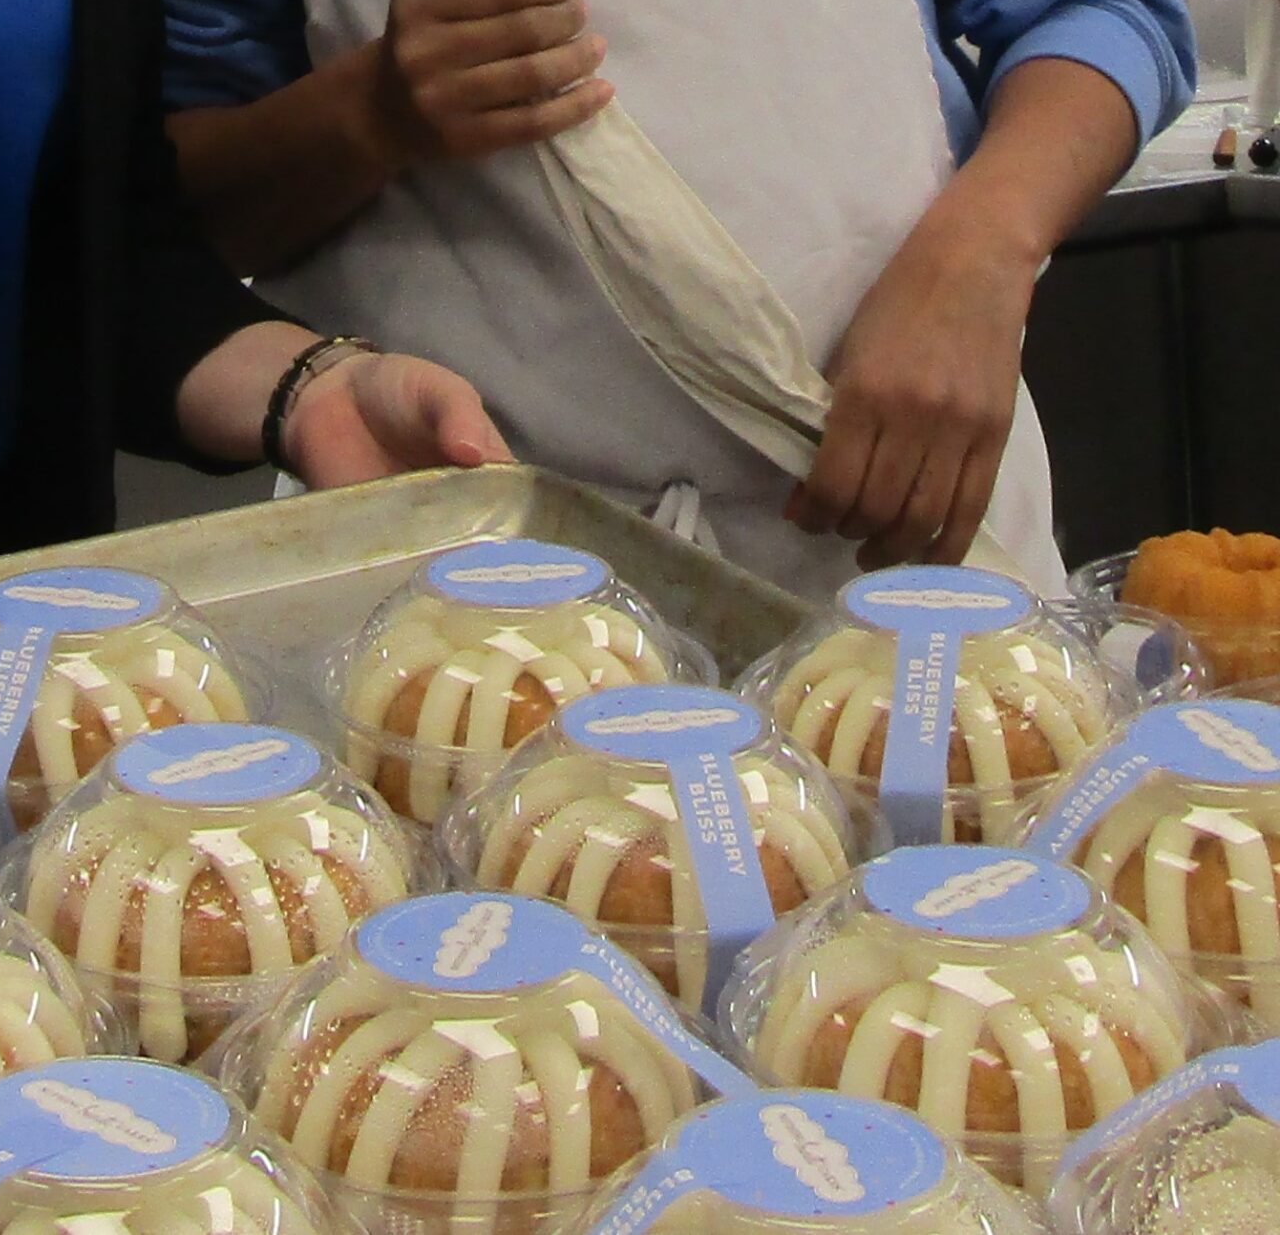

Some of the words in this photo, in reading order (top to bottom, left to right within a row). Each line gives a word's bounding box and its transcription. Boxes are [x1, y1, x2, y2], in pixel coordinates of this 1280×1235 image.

[904, 658, 925, 714] BLISS
[920, 631, 945, 745] BLUEBERRY
[688, 782, 718, 843] BLISS
[699, 753, 747, 875] BLUEBERRY
